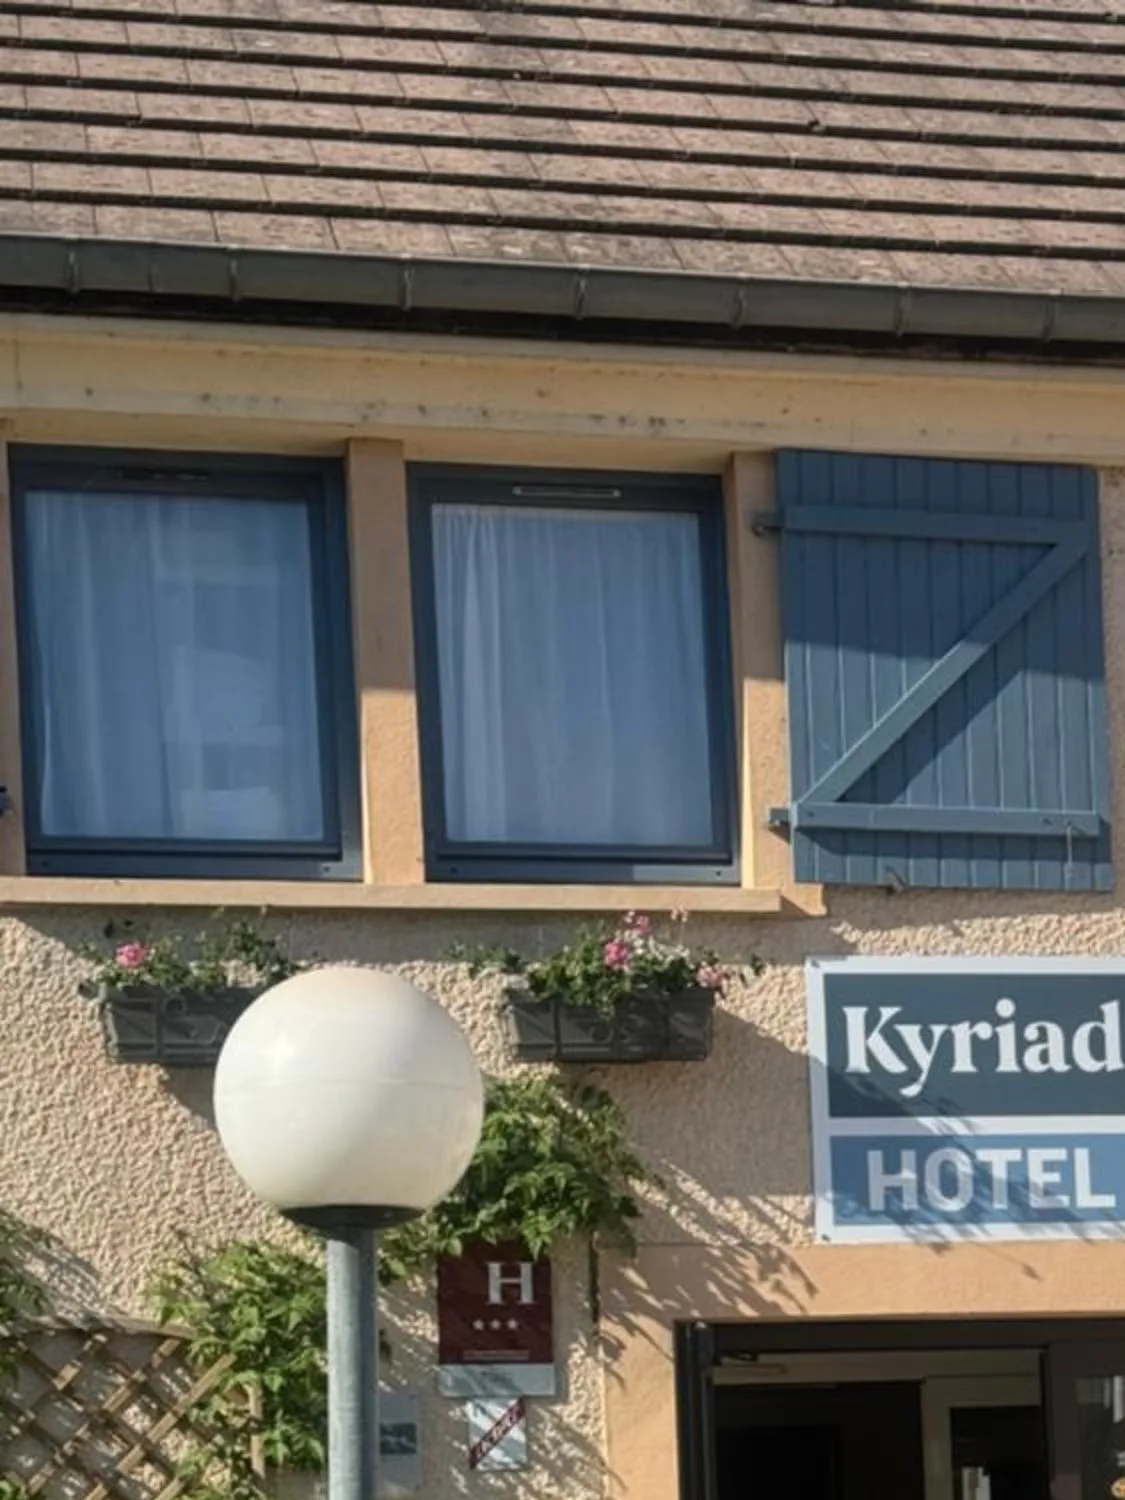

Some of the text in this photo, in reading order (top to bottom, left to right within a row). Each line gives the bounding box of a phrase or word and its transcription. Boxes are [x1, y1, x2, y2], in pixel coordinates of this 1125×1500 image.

[842, 997, 1125, 1097] Kyriad
[866, 1146, 1117, 1214] HOTEL
[486, 1261, 536, 1305] H
